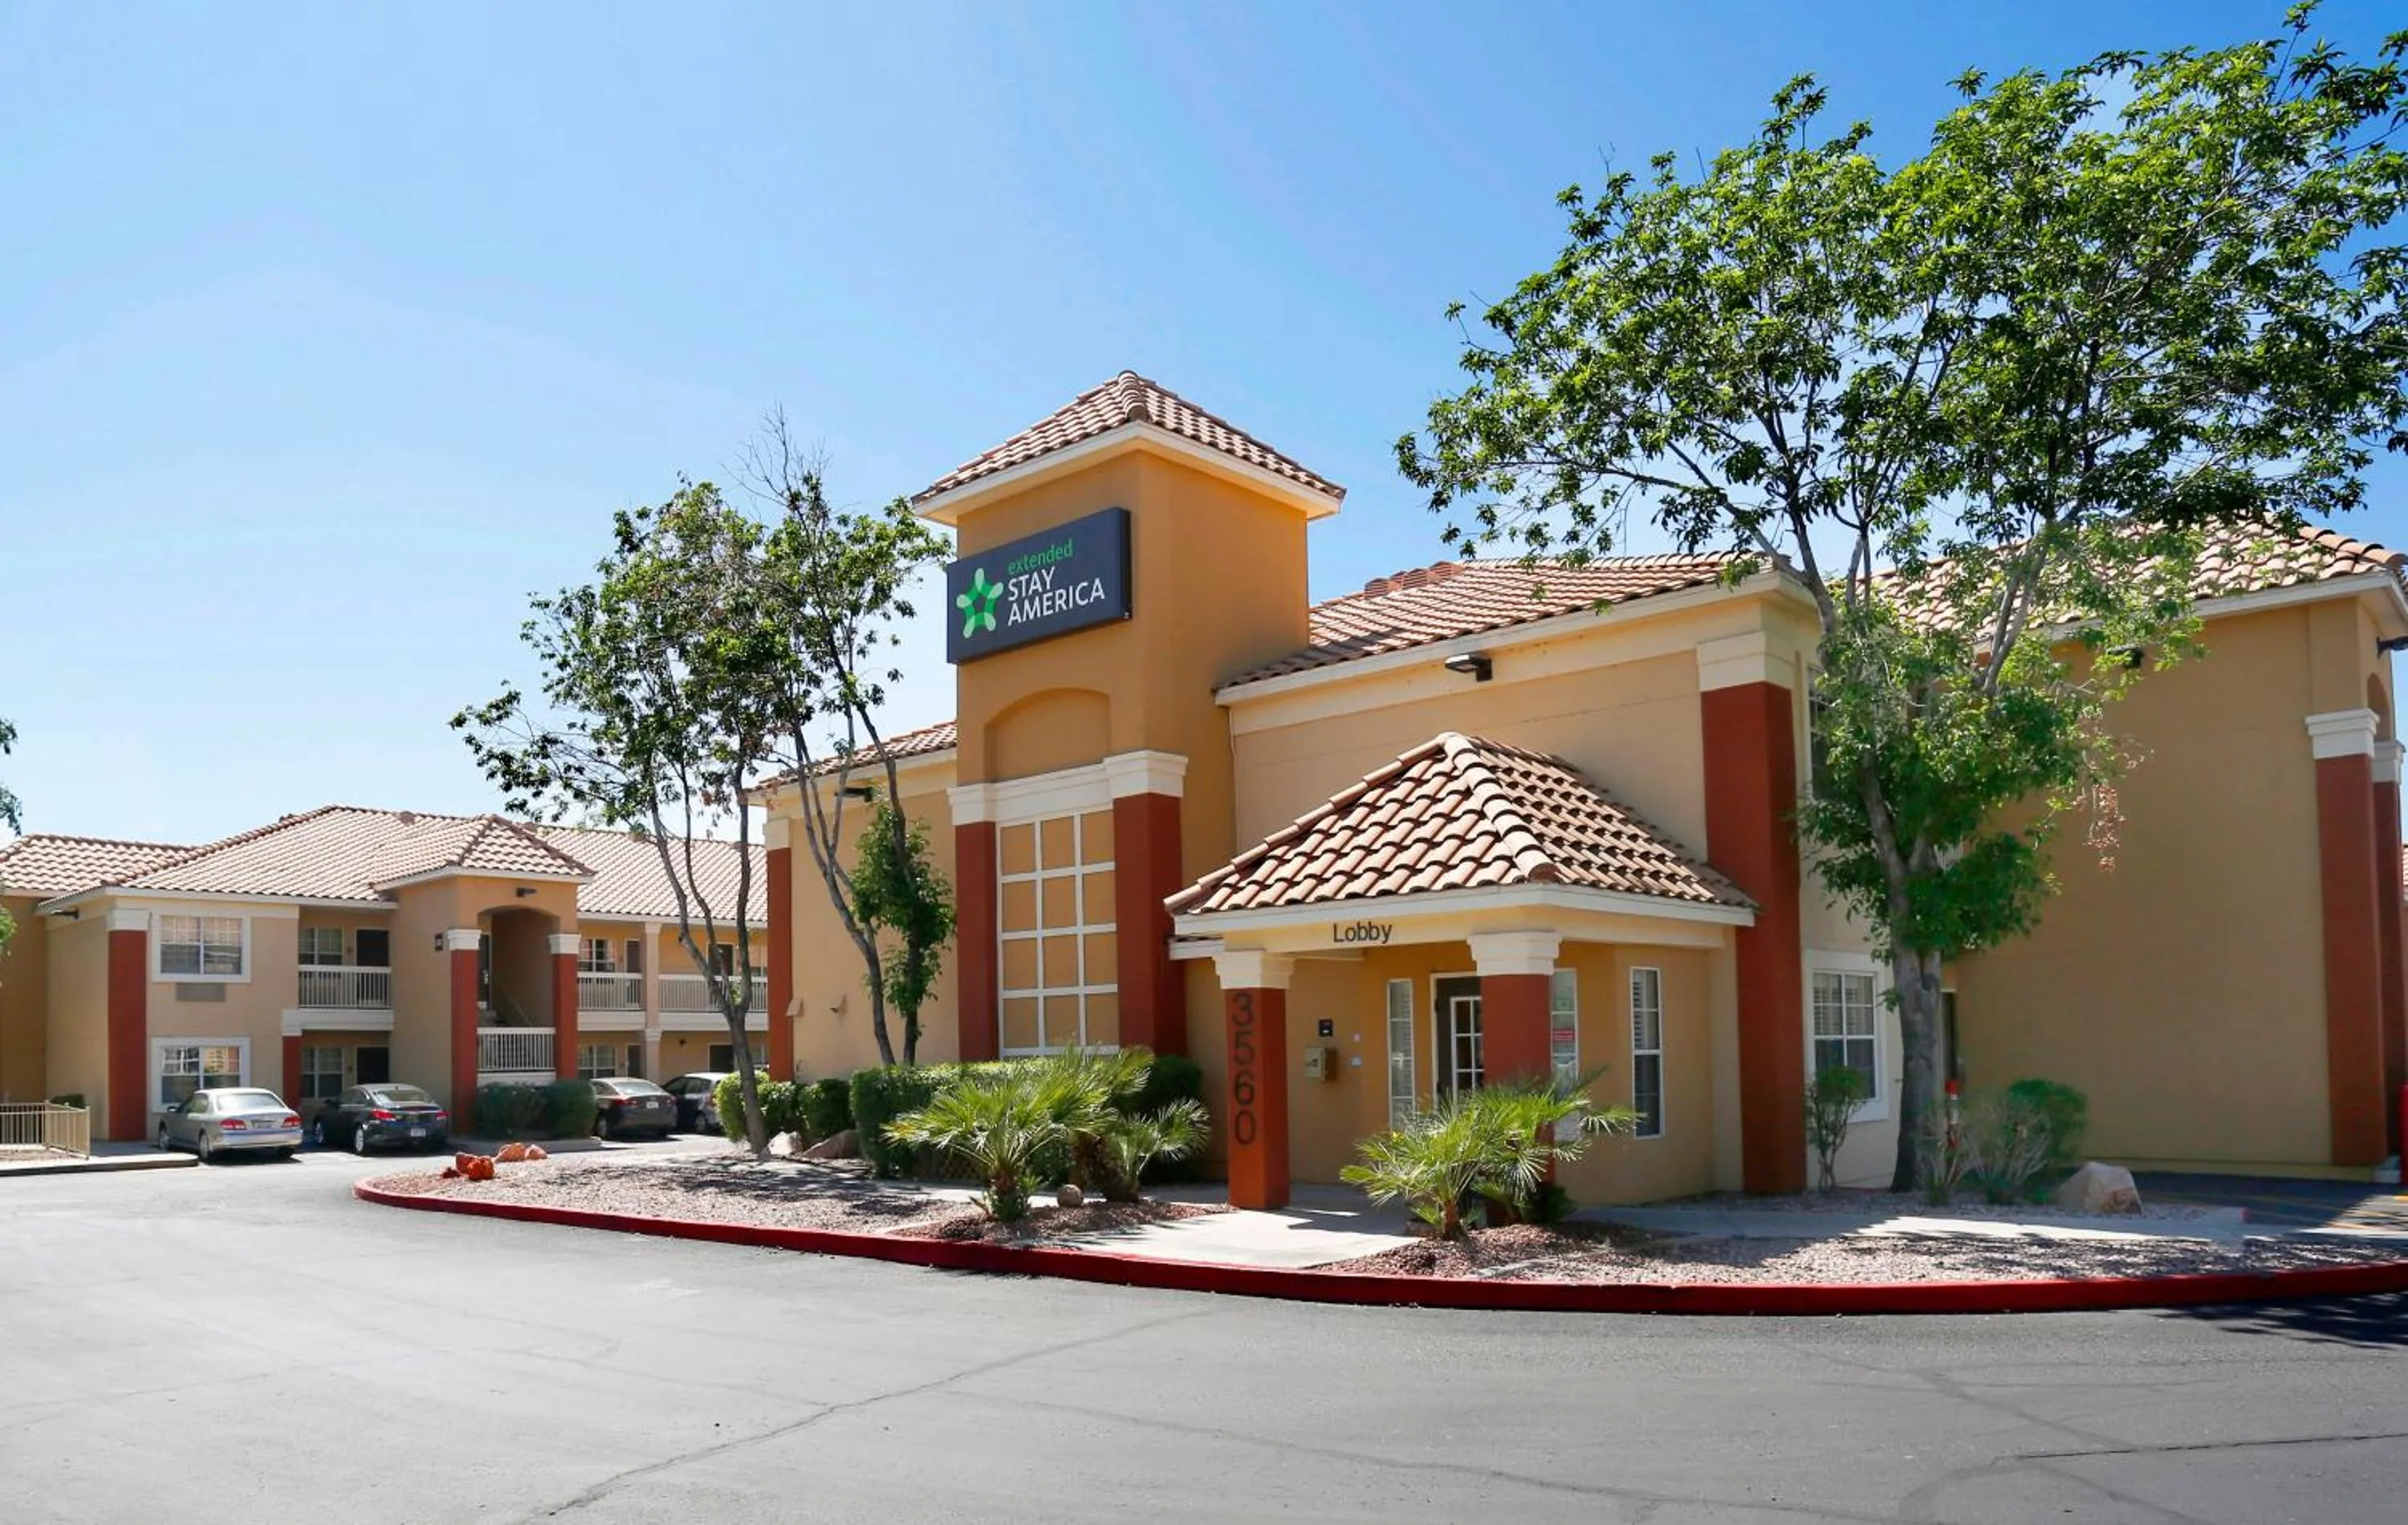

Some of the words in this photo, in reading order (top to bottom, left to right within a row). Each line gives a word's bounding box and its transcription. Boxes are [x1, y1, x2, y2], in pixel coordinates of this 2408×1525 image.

[1008, 539, 1073, 575] extended
[1007, 577, 1104, 626] AMERICA
[1008, 566, 1056, 601] STAY
[1333, 921, 1393, 944] Lobby
[1232, 992, 1256, 1145] 3560
